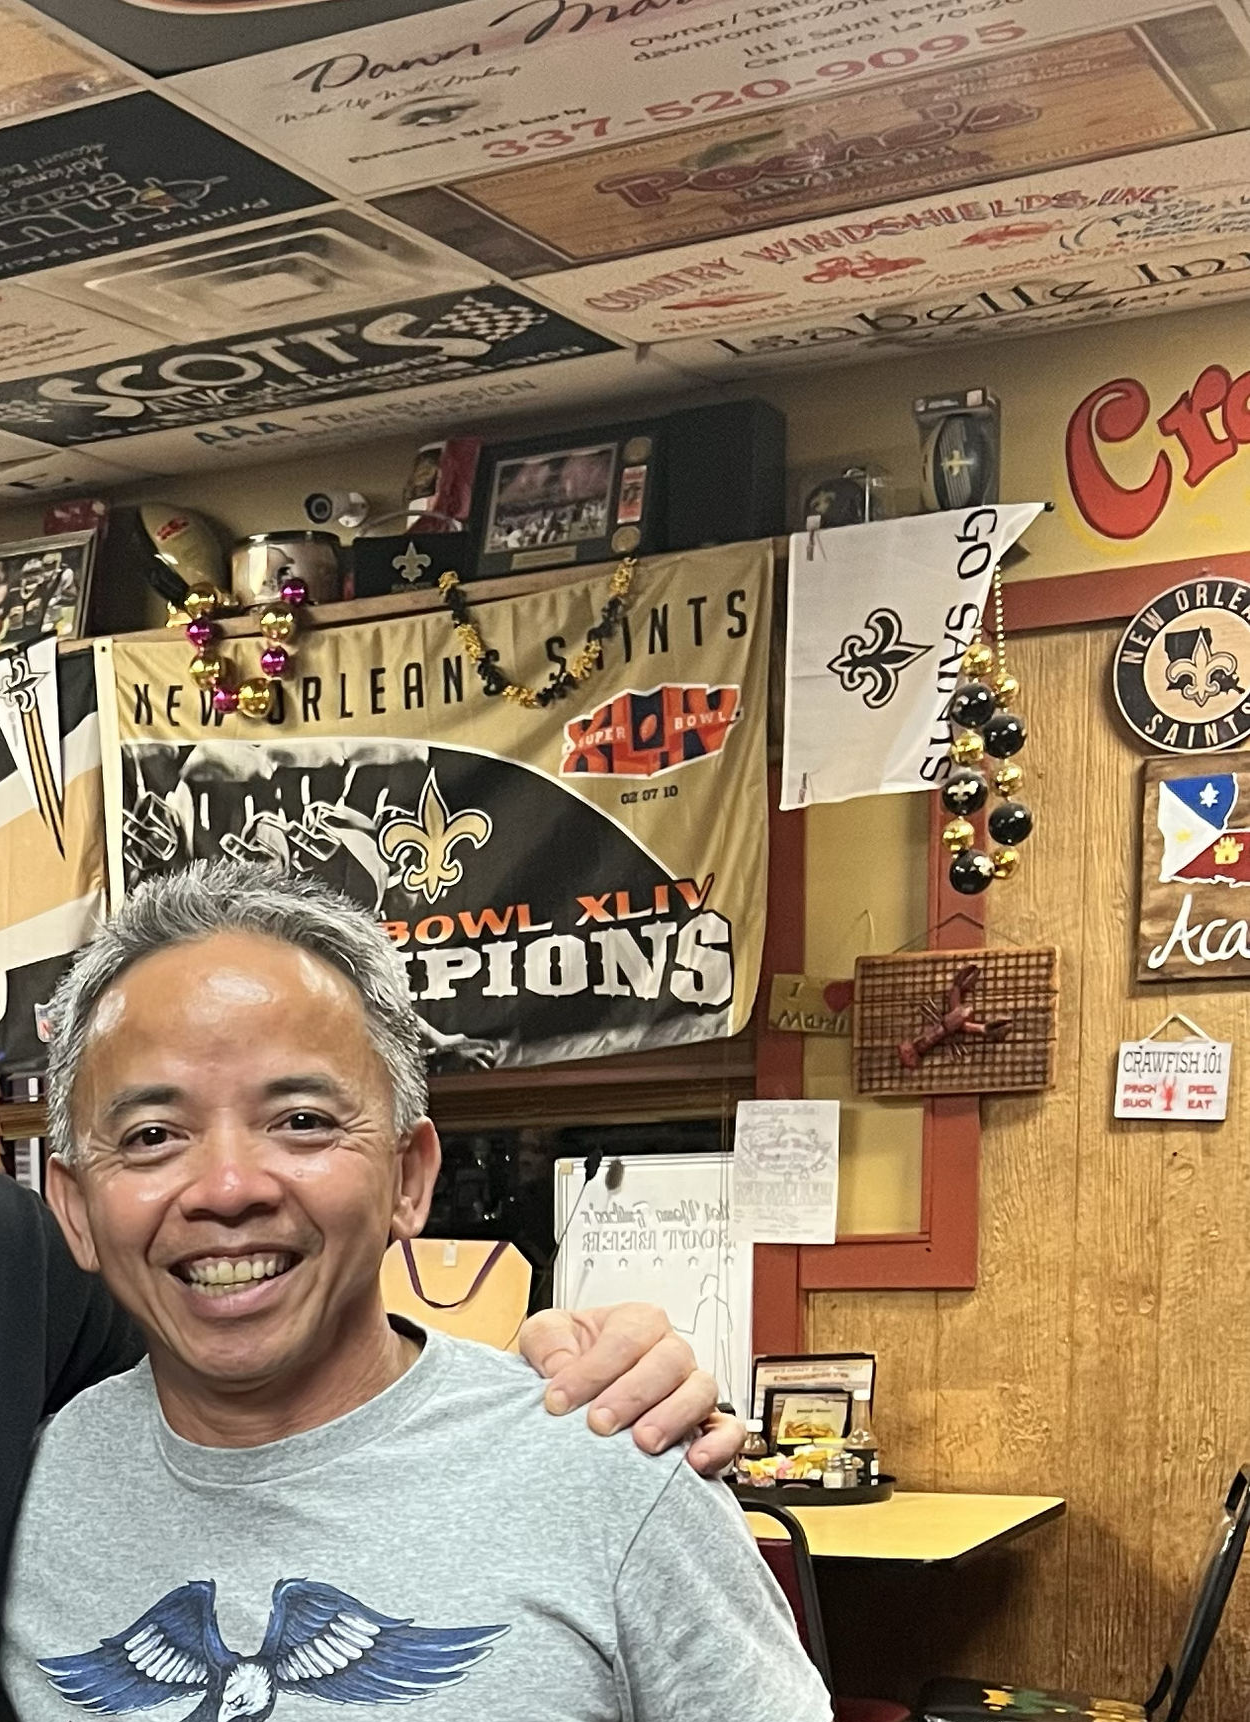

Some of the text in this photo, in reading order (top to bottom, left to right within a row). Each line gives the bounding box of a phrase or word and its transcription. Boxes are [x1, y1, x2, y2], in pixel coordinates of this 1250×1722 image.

[293, 41, 483, 94] Dawn
[481, 19, 1027, 159] 337-520-9095
[143, 198, 275, 231] Printing
[713, 279, 1108, 357] Isabelle
[38, 312, 491, 419] SCOTT'S
[192, 419, 293, 447] AAA
[953, 508, 998, 580] GO
[1120, 608, 1164, 666] NEW
[266, 645, 503, 725] RLEANS
[545, 588, 749, 686] SINTS
[576, 711, 726, 749] SUPER BOWL
[380, 872, 716, 946] BOWL XLIV
[777, 1006, 850, 1031] Mardi
[1123, 1051, 1222, 1078] CRAWFISH 101
[1123, 1084, 1157, 1094] PINCH
[1123, 1099, 1153, 1109] SUCK
[1187, 1100, 1213, 1110] EAT
[1188, 1085, 1217, 1095] PEEL
